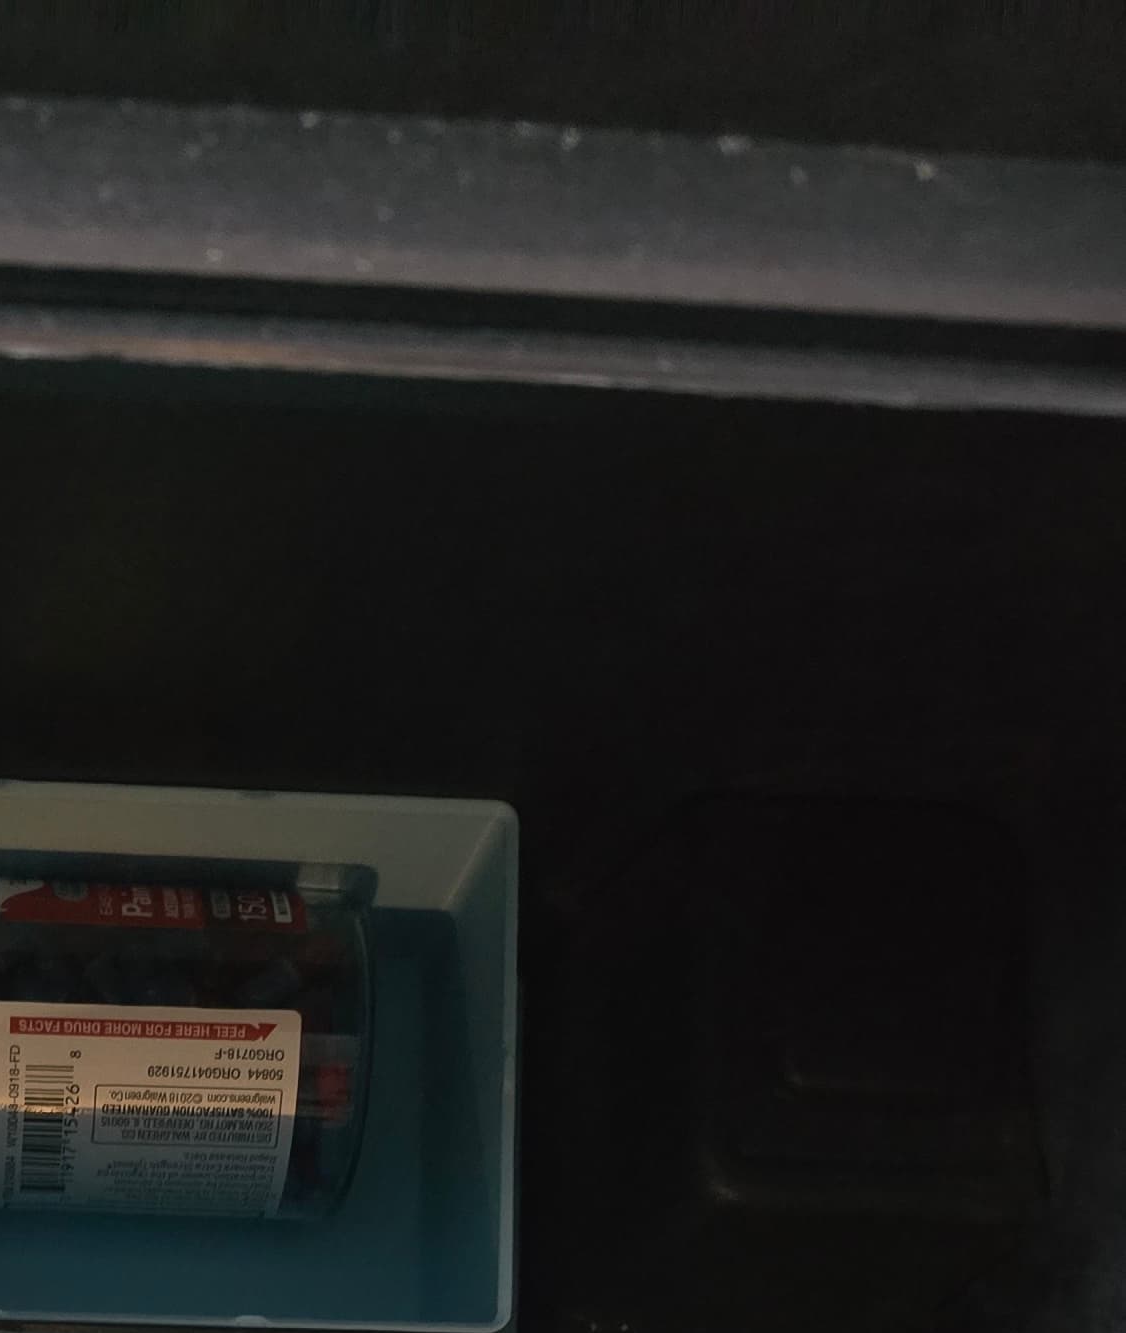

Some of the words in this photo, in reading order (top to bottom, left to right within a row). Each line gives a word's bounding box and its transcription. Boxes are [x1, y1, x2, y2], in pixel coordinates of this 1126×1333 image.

[18, 1020, 60, 1032] FACTS
[63, 1022, 100, 1034] DRUG
[104, 1024, 141, 1035] MORE
[146, 1026, 171, 1036] FOR
[176, 1027, 211, 1037] HERE
[220, 1028, 247, 1038] PEEL
[214, 1048, 285, 1061] ORG0718-F
[248, 1069, 283, 1080] 50844
[125, 1090, 167, 1102] Walgreen
[207, 1093, 276, 1105] walgreens.com
[102, 1103, 171, 1115] GUARANTEED
[174, 1106, 245, 1118] SATISFACTION
[249, 1109, 274, 1119] 100%
